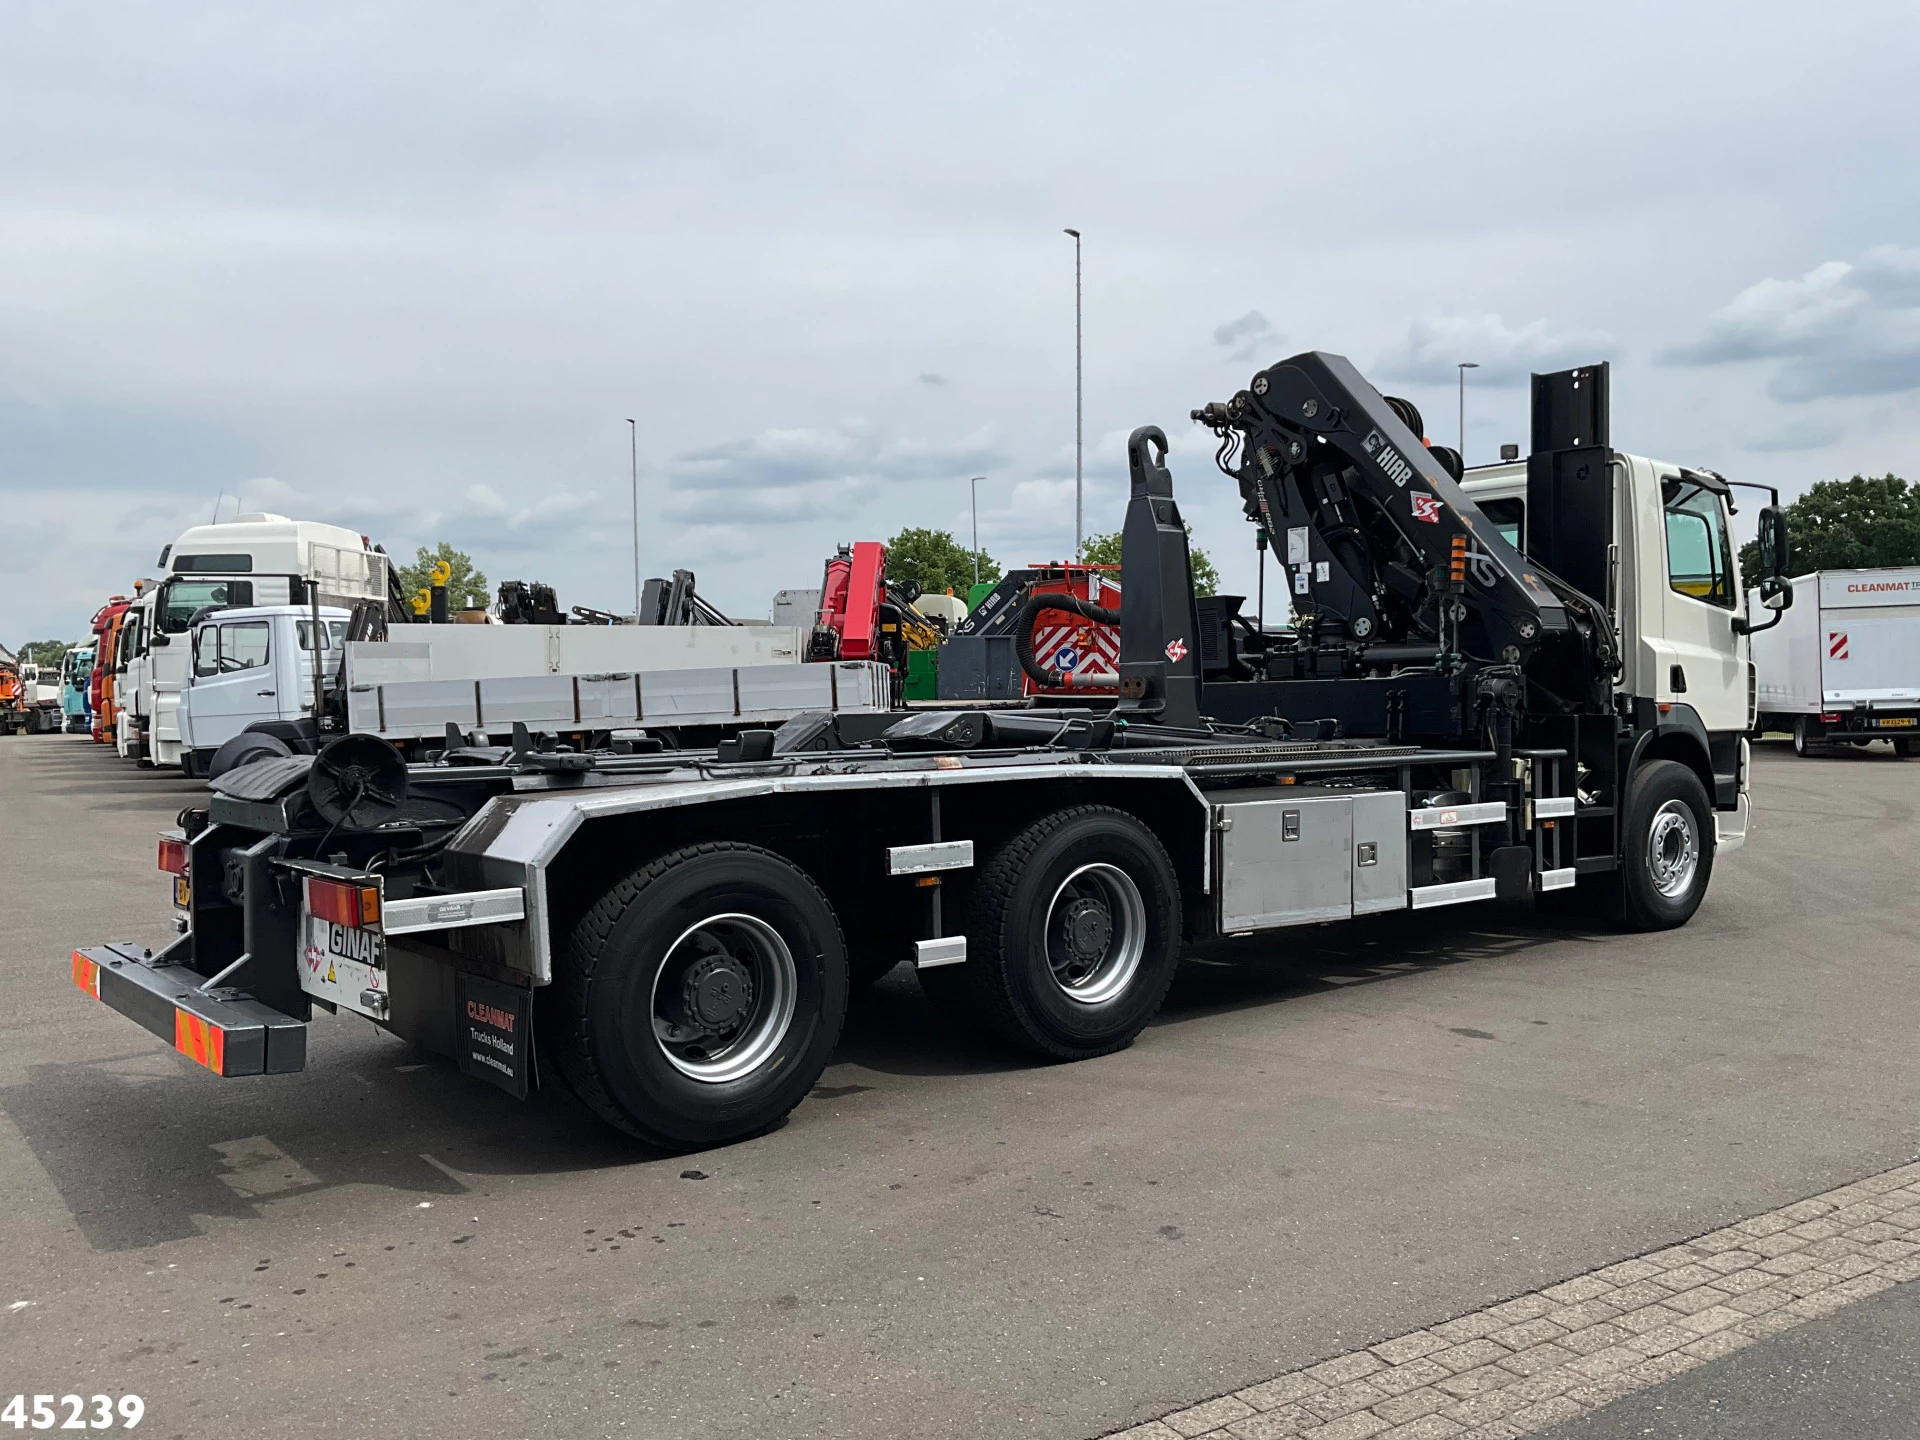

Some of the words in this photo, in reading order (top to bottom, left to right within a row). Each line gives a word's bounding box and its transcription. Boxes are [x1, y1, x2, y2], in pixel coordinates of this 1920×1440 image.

[1376, 446, 1413, 488] HIAB
[984, 592, 1001, 610] HIAB
[1847, 581, 1910, 593] CLEANMAT
[330, 922, 380, 965] GINAF
[467, 1000, 515, 1033] CLEANMAT
[470, 1027, 491, 1045] Trucks
[491, 1034, 514, 1056] Holland
[471, 1051, 514, 1078] www.cleanmat.eu
